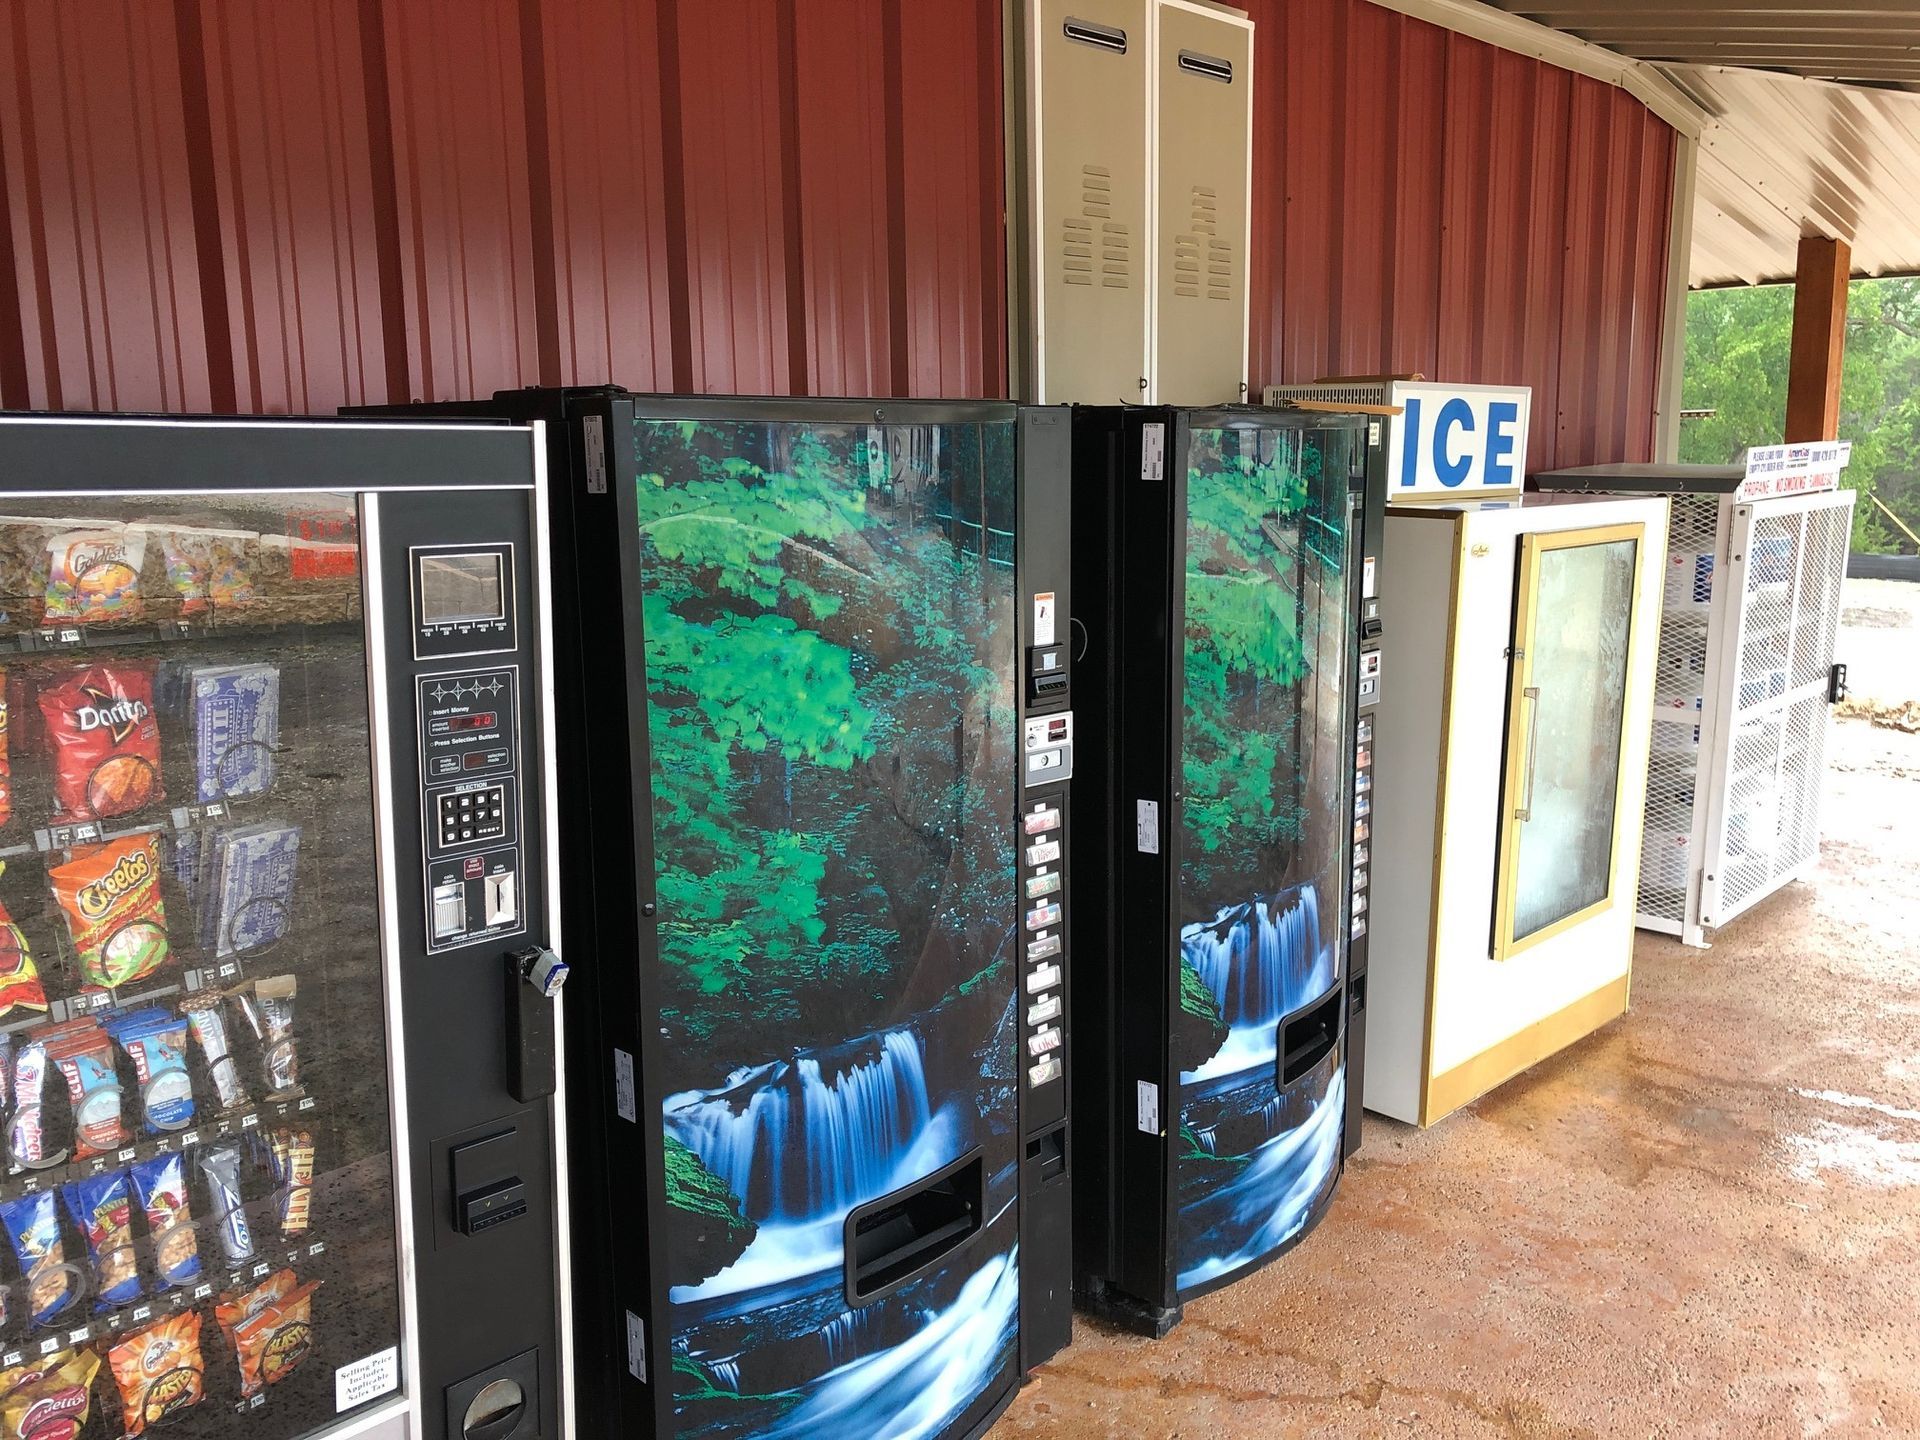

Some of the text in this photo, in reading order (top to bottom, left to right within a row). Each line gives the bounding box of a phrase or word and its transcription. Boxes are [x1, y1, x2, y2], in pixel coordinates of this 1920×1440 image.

[1401, 397, 1518, 488] ICE
[74, 544, 127, 573] Goldfish
[240, 734, 249, 759] Buter
[434, 739, 450, 747] Press
[451, 735, 478, 744] Selection
[455, 782, 488, 792] SELECTION
[461, 798, 469, 806] 2
[477, 796, 485, 804] 3
[446, 809, 500, 825] 5 6 7 8
[447, 826, 500, 841] 9 0 RESET
[80, 854, 149, 916] Cheetos
[198, 1009, 217, 1041] KIND
[129, 1044, 147, 1076] CLIF
[62, 1061, 83, 1093] CLIF
[93, 1198, 128, 1219] PLANTER
[340, 1356, 392, 1379] Selling Price
[349, 1368, 384, 1385] Includes
[346, 1373, 389, 1394] Applicable
[348, 1383, 385, 1401] Sales Tax
